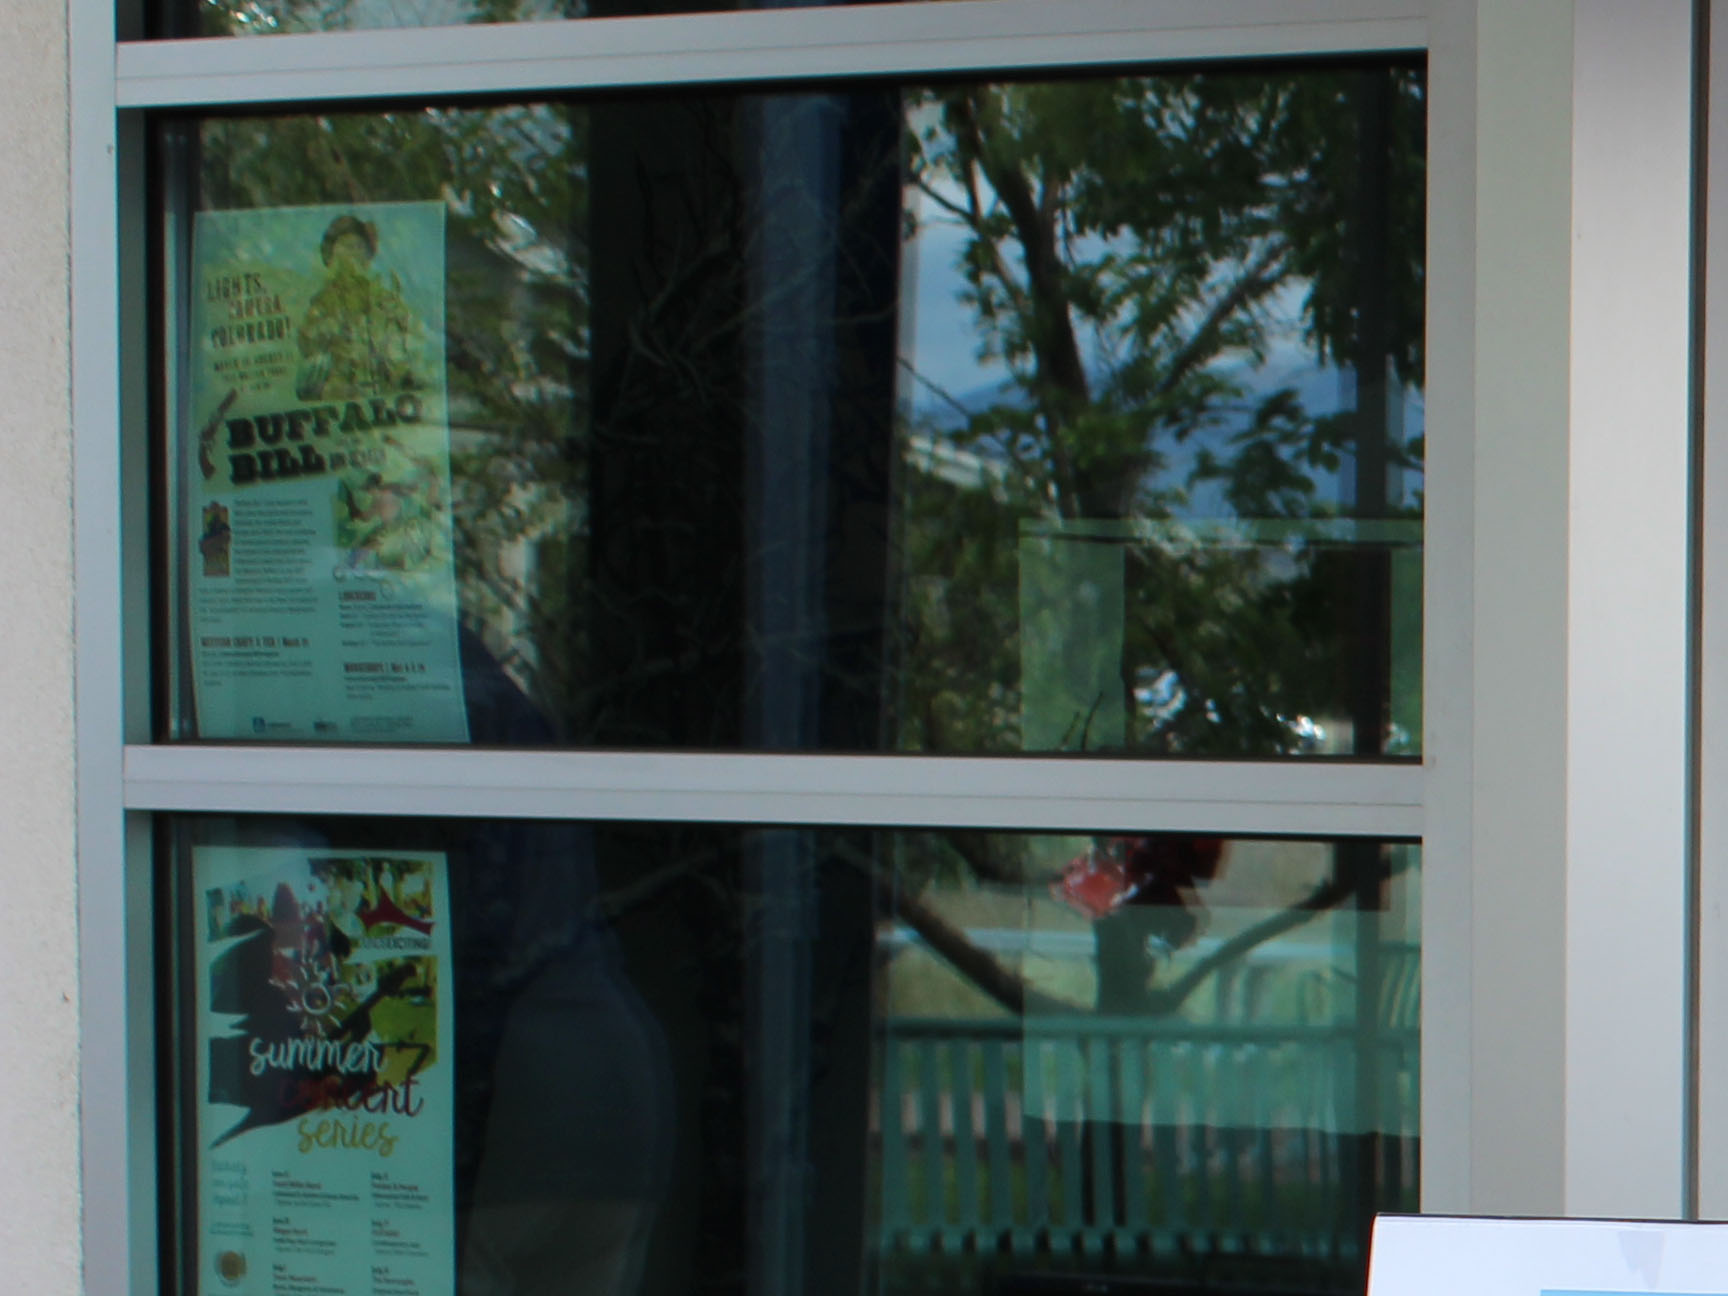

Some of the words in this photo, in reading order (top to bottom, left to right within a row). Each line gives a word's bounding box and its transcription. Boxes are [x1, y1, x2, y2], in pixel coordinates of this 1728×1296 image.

[225, 393, 422, 448] BUFFALO
[228, 444, 326, 485] BILL
[248, 1035, 386, 1076] summer
[298, 1116, 399, 1157] series
